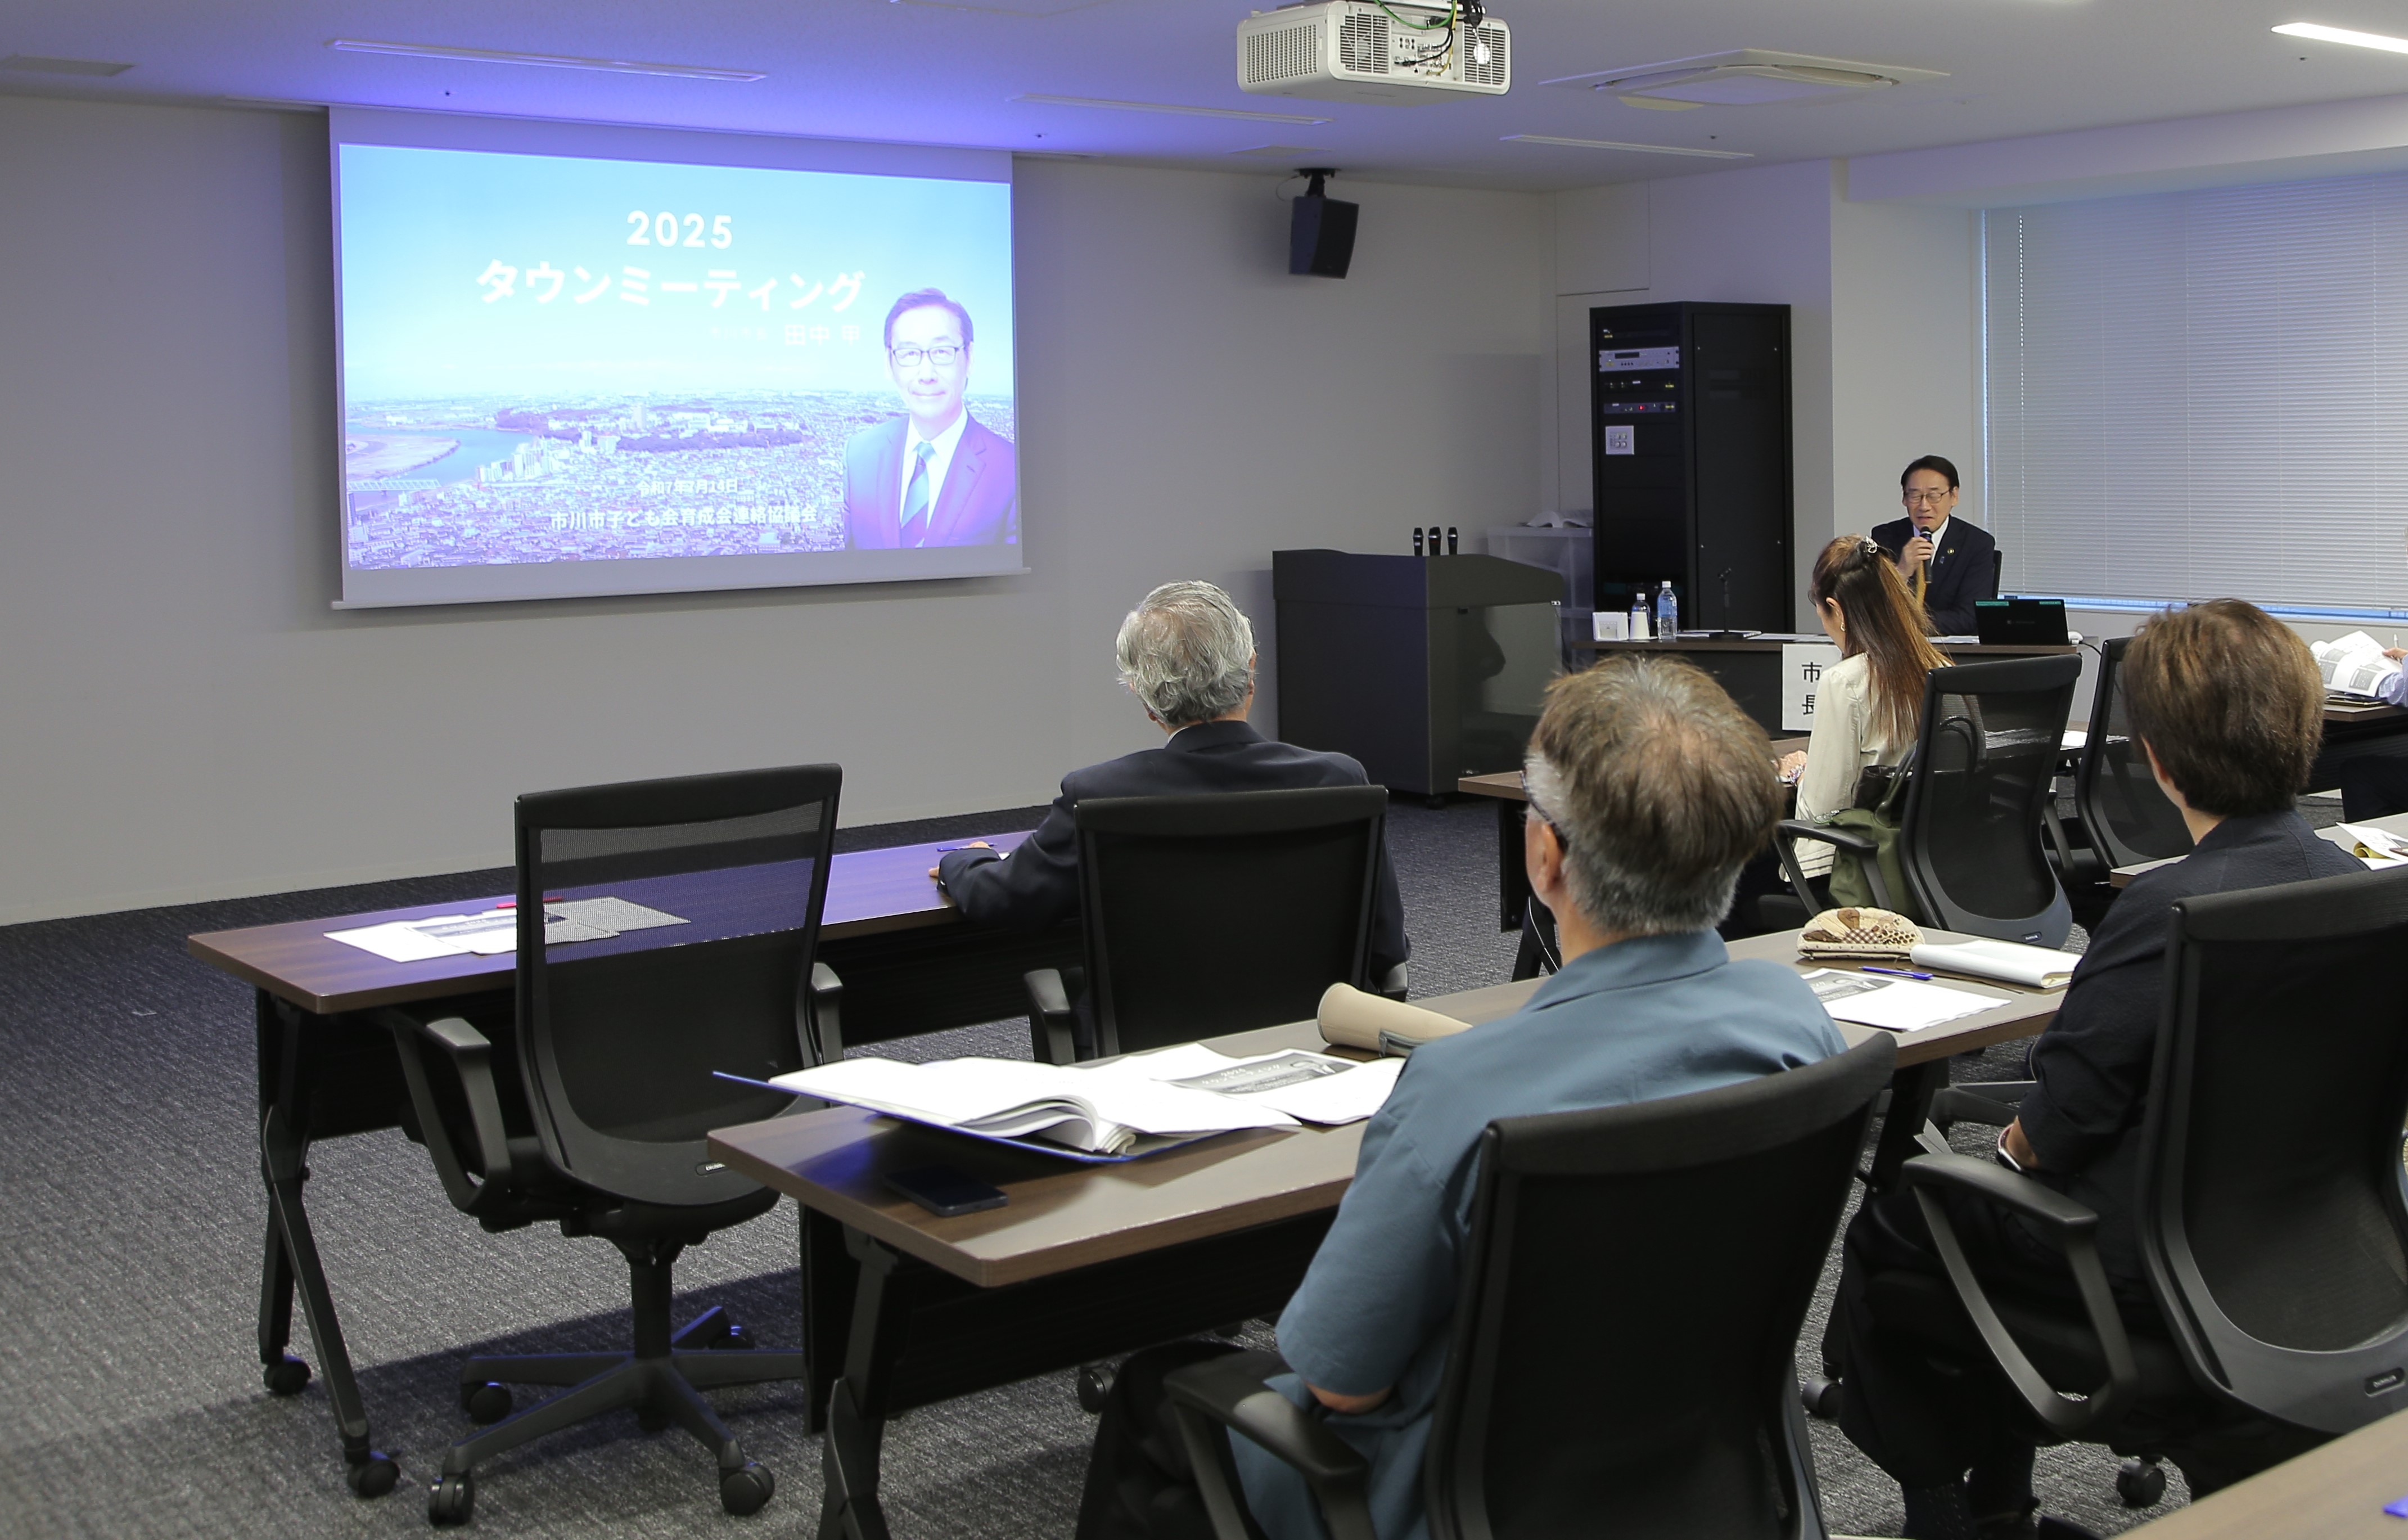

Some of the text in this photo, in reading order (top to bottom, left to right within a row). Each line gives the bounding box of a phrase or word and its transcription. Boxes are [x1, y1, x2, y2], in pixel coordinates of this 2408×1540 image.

[627, 210, 733, 249] 2025
[476, 259, 865, 312] タウンミーティング
[784, 324, 830, 346] 田中
[550, 503, 817, 530] 市川市子ども会育成会連絡協議会
[1801, 661, 1823, 715] 市長
